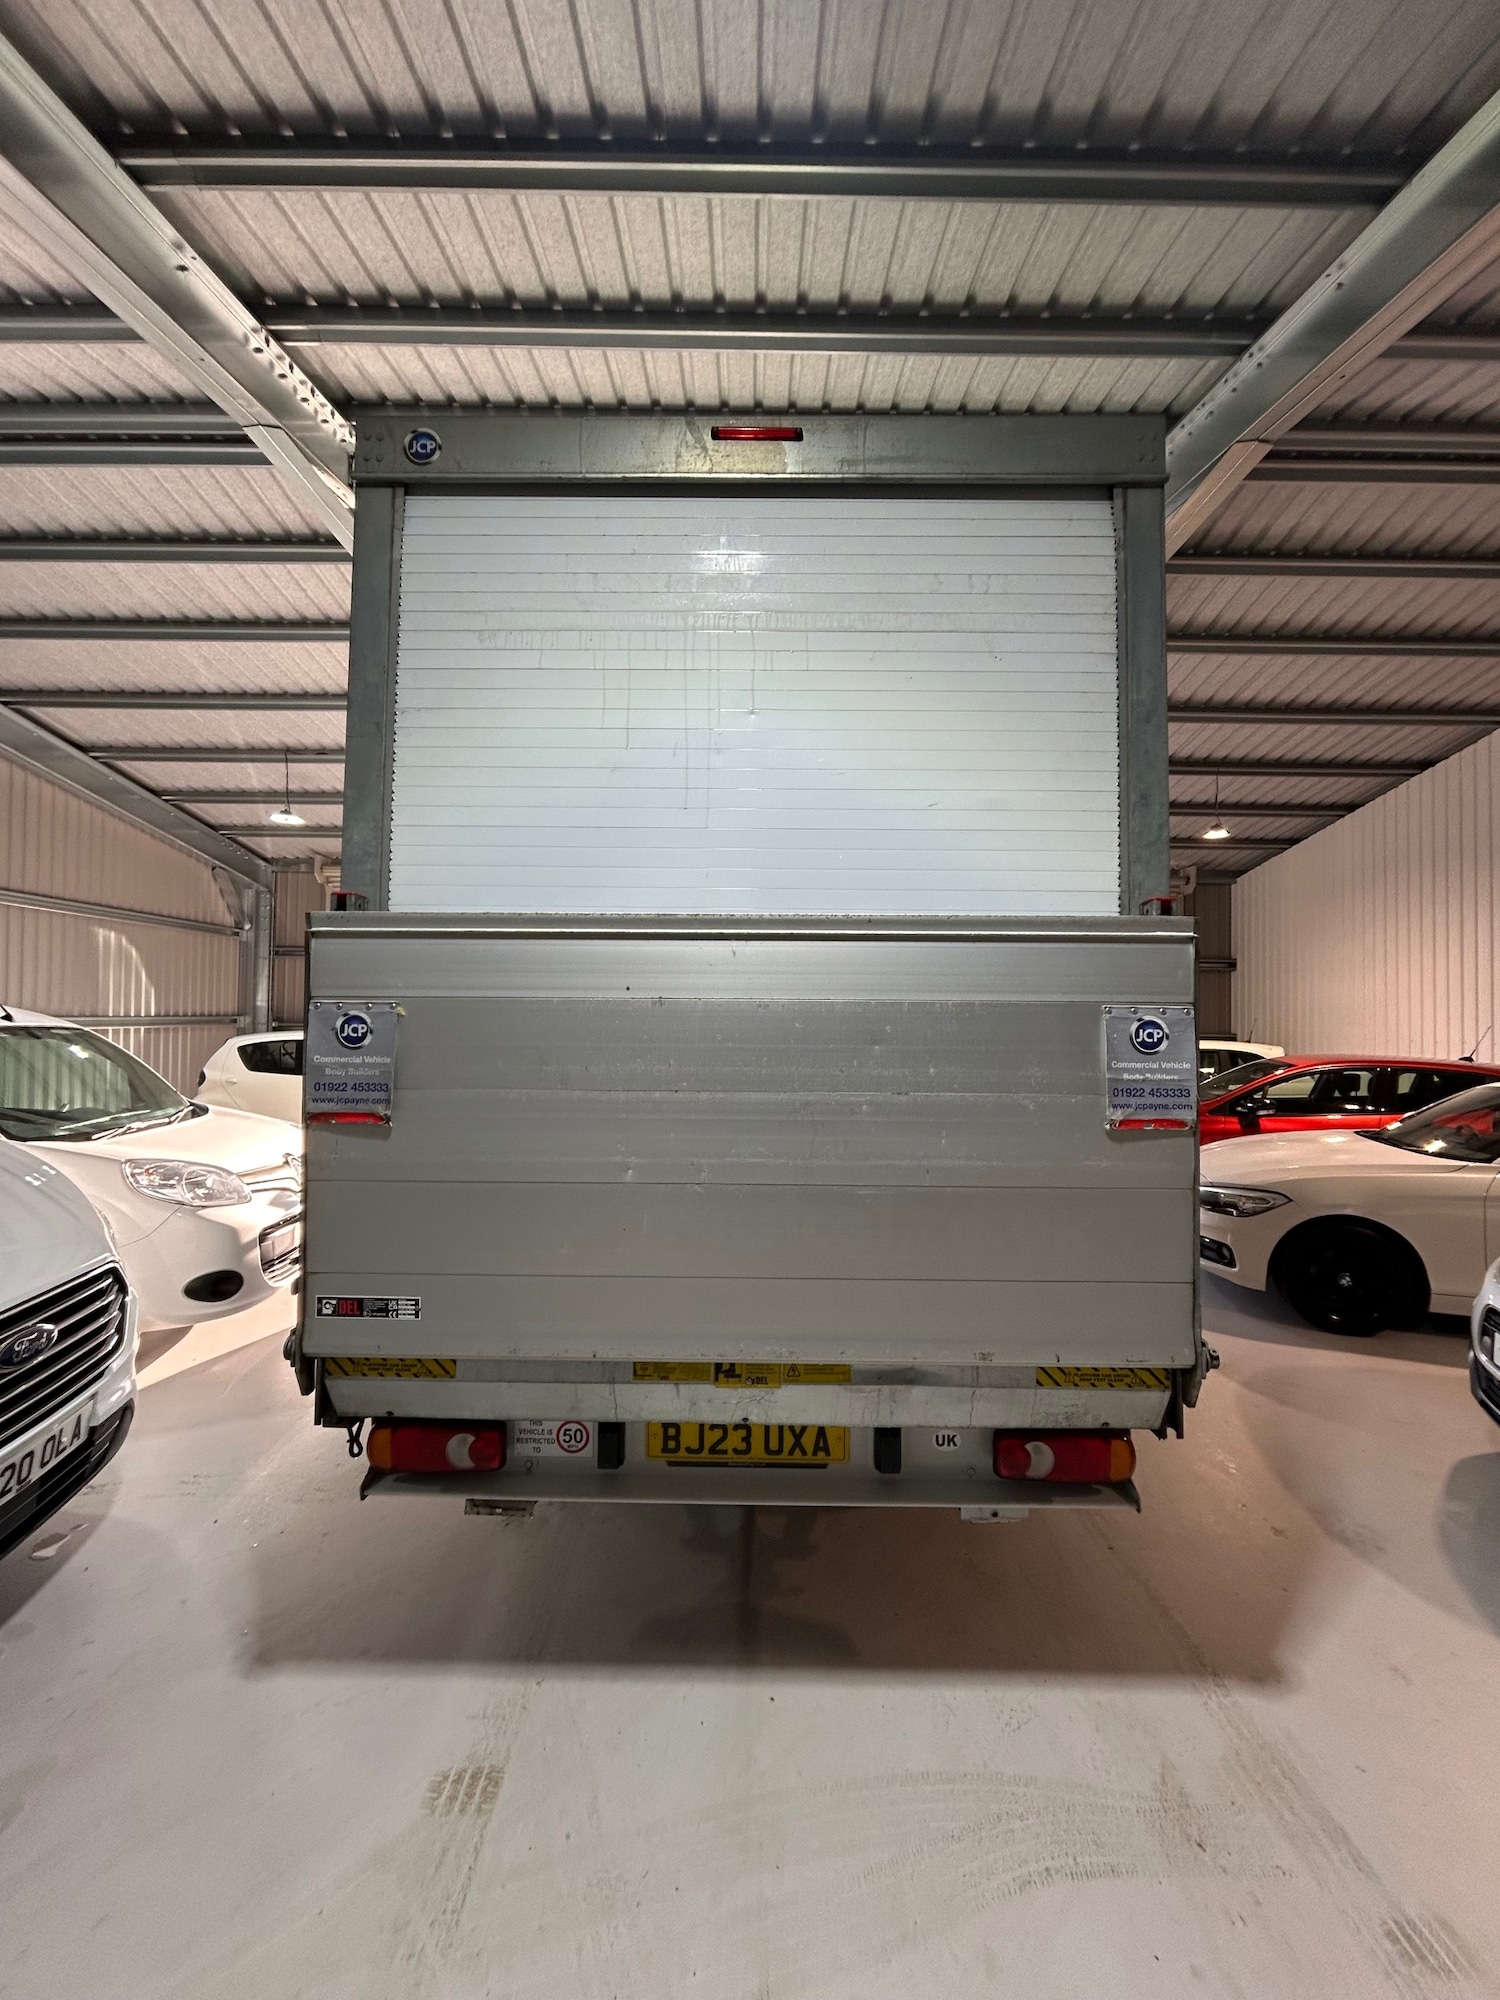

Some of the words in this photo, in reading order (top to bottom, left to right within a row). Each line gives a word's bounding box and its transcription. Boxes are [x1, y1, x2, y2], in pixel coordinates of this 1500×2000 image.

[410, 440, 436, 453] JCP
[341, 1023, 368, 1037] JCP
[1136, 1029, 1163, 1042] JCP
[313, 1055, 362, 1064] Commercial
[363, 1055, 391, 1064] Vehicle
[1111, 1060, 1159, 1069] Commercial
[1160, 1061, 1191, 1069] Vehicle
[325, 1067, 346, 1076] Body
[348, 1067, 380, 1076] Builders
[1123, 1072, 1143, 1080] Body
[314, 1081, 348, 1092] 01922
[351, 1082, 389, 1092] 453333
[1113, 1087, 1145, 1098] 01922
[1148, 1088, 1191, 1098] 453333
[312, 1096, 391, 1105] www.jcpayne.com
[1111, 1102, 1193, 1111] www.jcpayne.com
[339, 1300, 360, 1315] DEL
[12, 1332, 49, 1363] Ford
[755, 1376, 769, 1385] DEL
[518, 1428, 546, 1436] VEHICLE
[547, 1428, 553, 1436] IS
[562, 1428, 583, 1444] 50
[516, 1437, 556, 1445] RESTRICTED
[660, 1422, 752, 1456] BJ23
[764, 1424, 832, 1457] UXA
[935, 1434, 958, 1448] UK
[0, 1450, 35, 1498] 20
[40, 1414, 82, 1469] OLA
